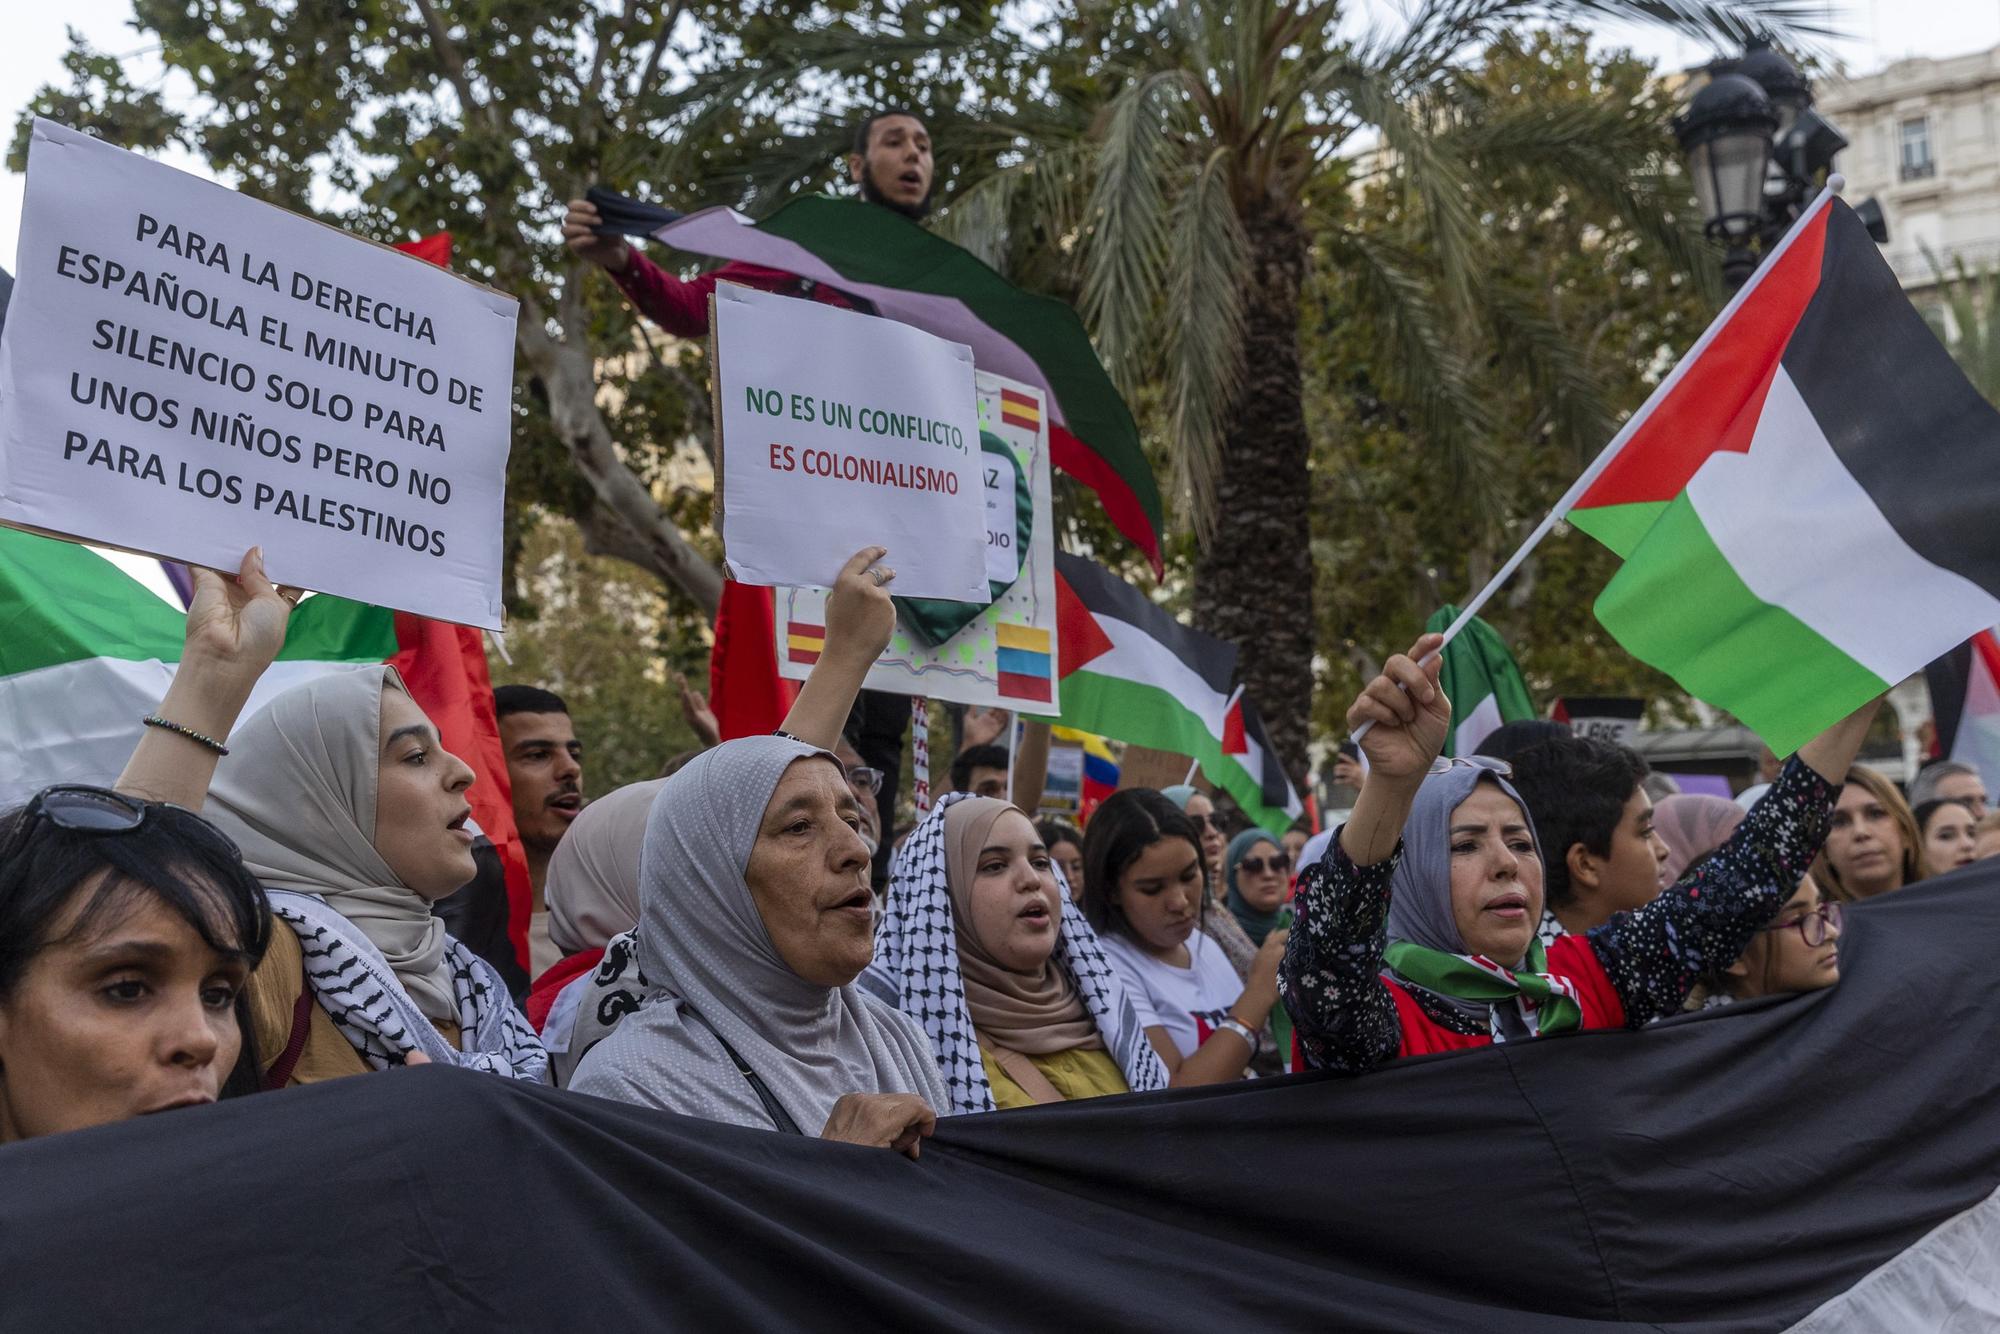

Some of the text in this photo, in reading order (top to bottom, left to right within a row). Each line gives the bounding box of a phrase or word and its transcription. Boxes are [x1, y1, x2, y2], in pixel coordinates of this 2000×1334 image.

[56, 244, 484, 414] ESPAÑOLA EL MINUTO DE
[136, 213, 437, 346] PARA LA DERECHA
[70, 371, 451, 505] UNOS NIÑOS PERO NO
[92, 319, 446, 453] SILENCIO SOLO PARA
[745, 385, 969, 456] NO ES UN CONFLICTO,
[63, 430, 446, 557] PARA LOS PALESTINOS
[769, 443, 958, 496] ES COLONIALISMO
